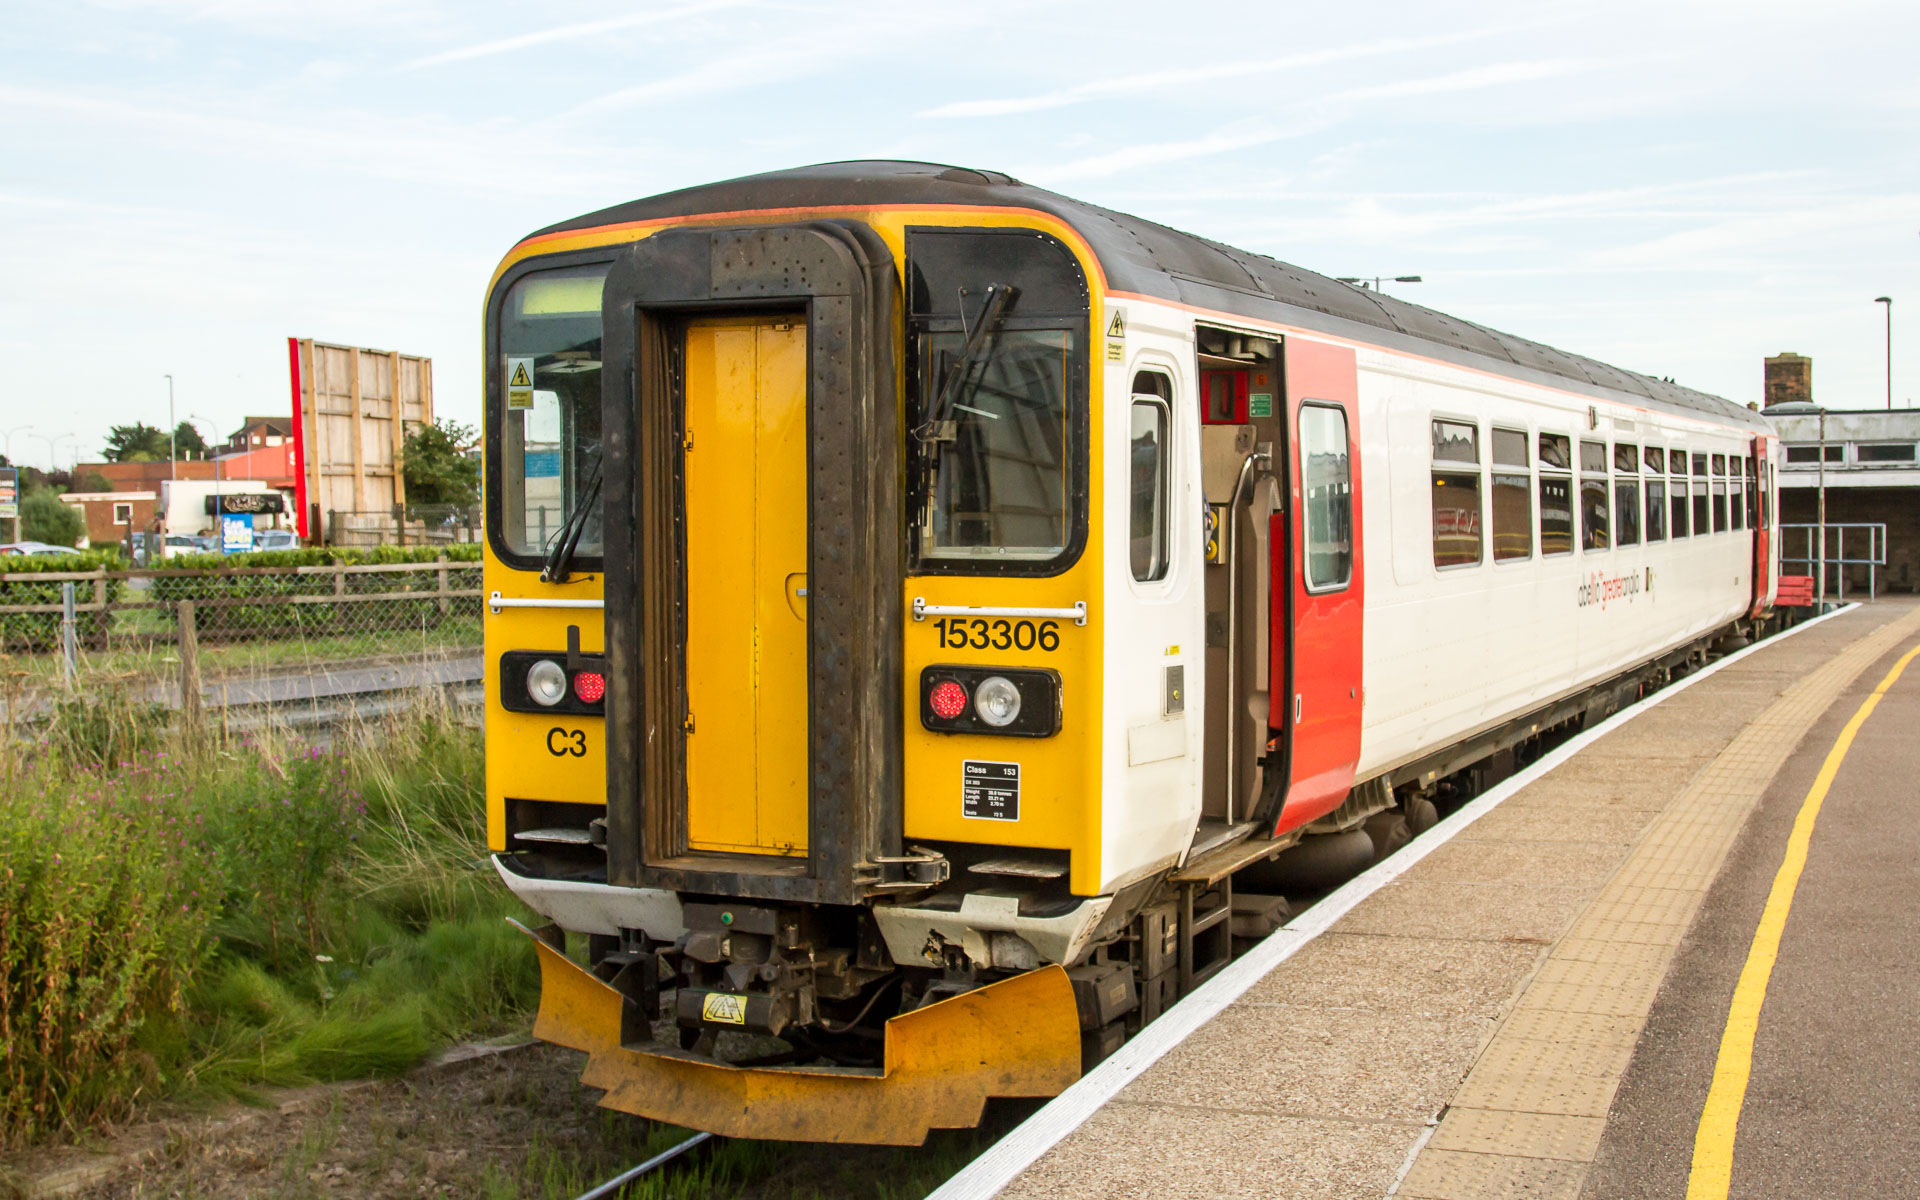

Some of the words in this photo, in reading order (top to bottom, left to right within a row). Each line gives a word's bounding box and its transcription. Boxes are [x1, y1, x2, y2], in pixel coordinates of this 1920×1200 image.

[224, 535, 252, 544] OPEN
[933, 618, 1060, 652] 153306
[547, 726, 587, 758] C3
[966, 765, 987, 774] Class
[1003, 768, 1016, 776] 153
